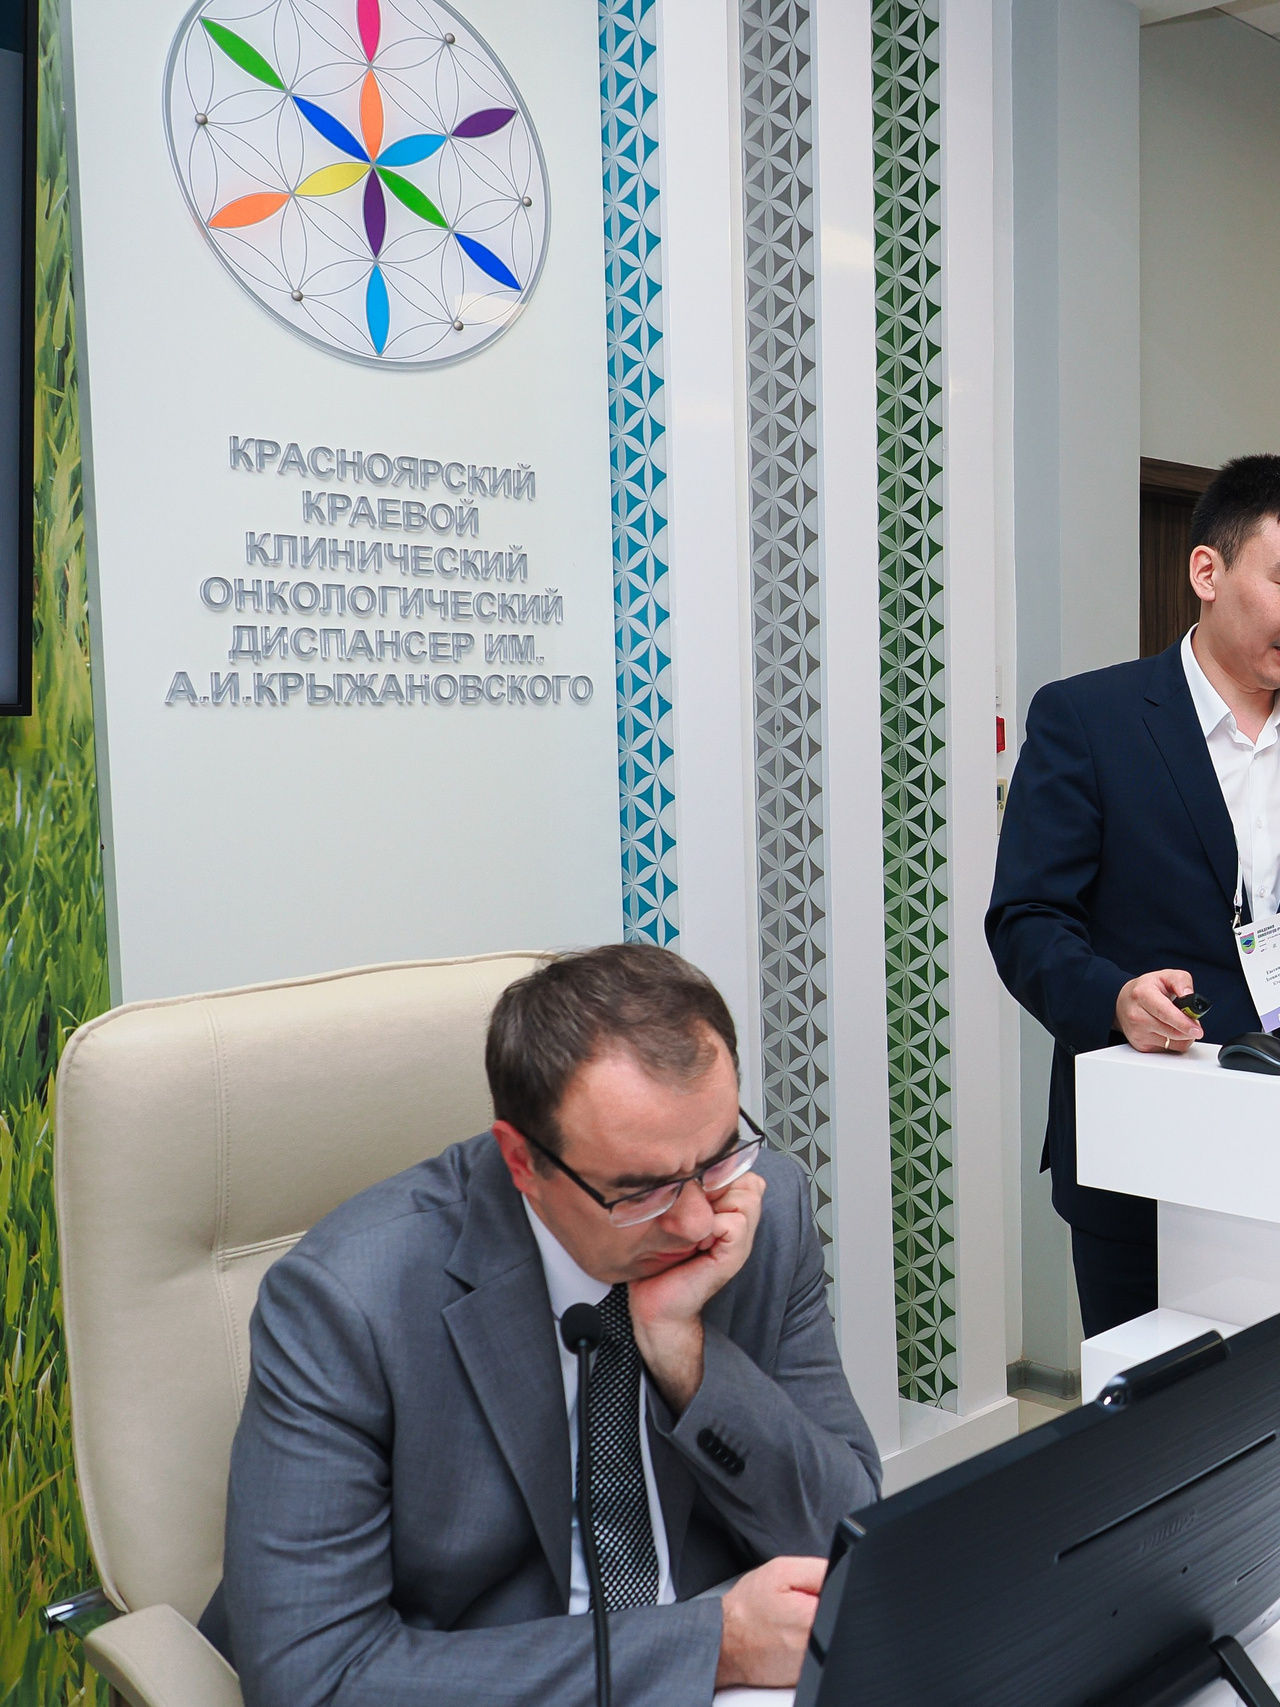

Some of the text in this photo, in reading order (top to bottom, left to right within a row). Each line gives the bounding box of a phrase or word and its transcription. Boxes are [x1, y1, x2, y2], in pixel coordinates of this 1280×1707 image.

[229, 435, 537, 500] КРАСНОЯРСКИЙ
[302, 490, 480, 537] КРАЕВОЙ
[245, 531, 528, 582] КЛИНИЧЕСКИЙ
[200, 576, 564, 625] ОНКОЛОГИЧЕСКИЙ
[228, 625, 546, 665] ДИСПАНСЕР ИМ.
[164, 671, 595, 706] А.И.КРЫЖАНОВСКОГО
